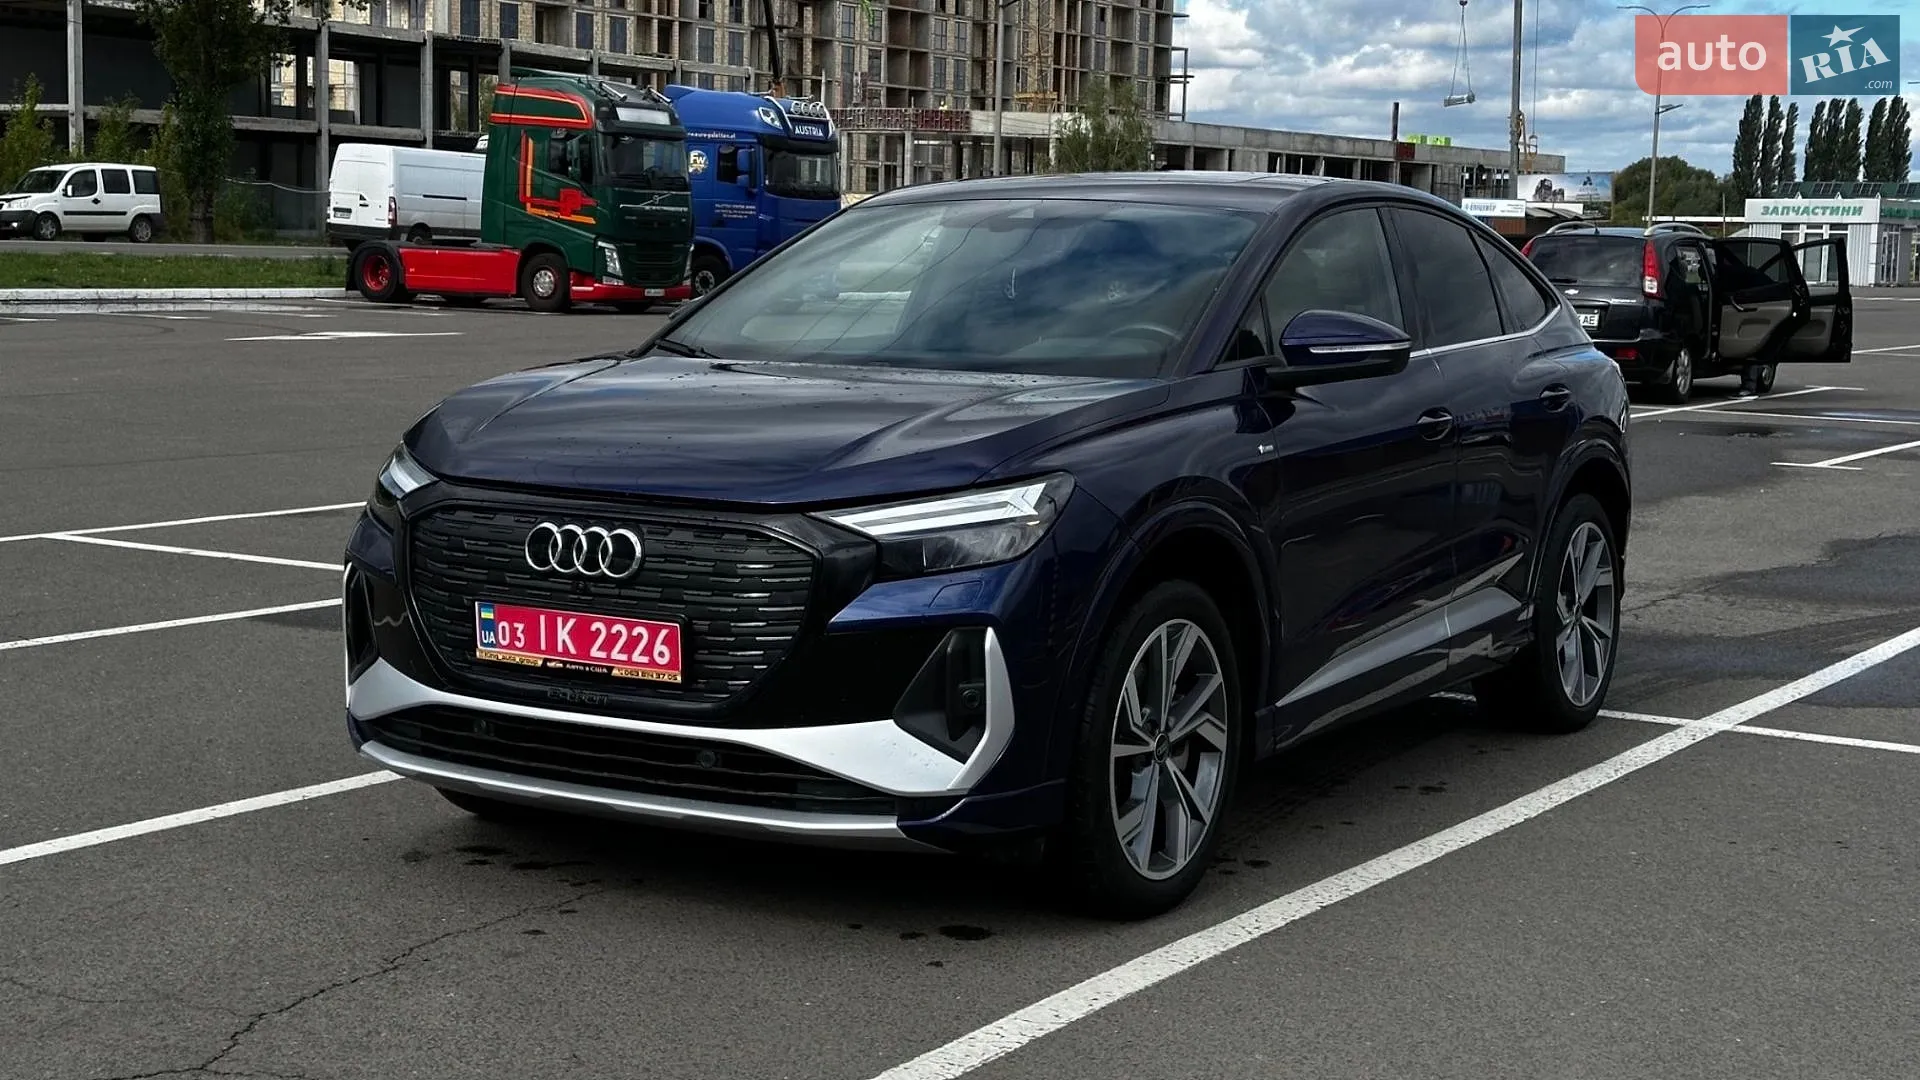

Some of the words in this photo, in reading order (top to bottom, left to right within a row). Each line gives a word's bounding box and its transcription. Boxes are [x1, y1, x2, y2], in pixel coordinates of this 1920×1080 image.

[794, 125, 824, 138] AUSTRIA
[1760, 205, 1864, 217] ЗАПЧАСТИНИ
[481, 630, 496, 645] UA
[498, 620, 526, 648] 03
[539, 614, 577, 655] IK
[589, 621, 671, 666] 2226
